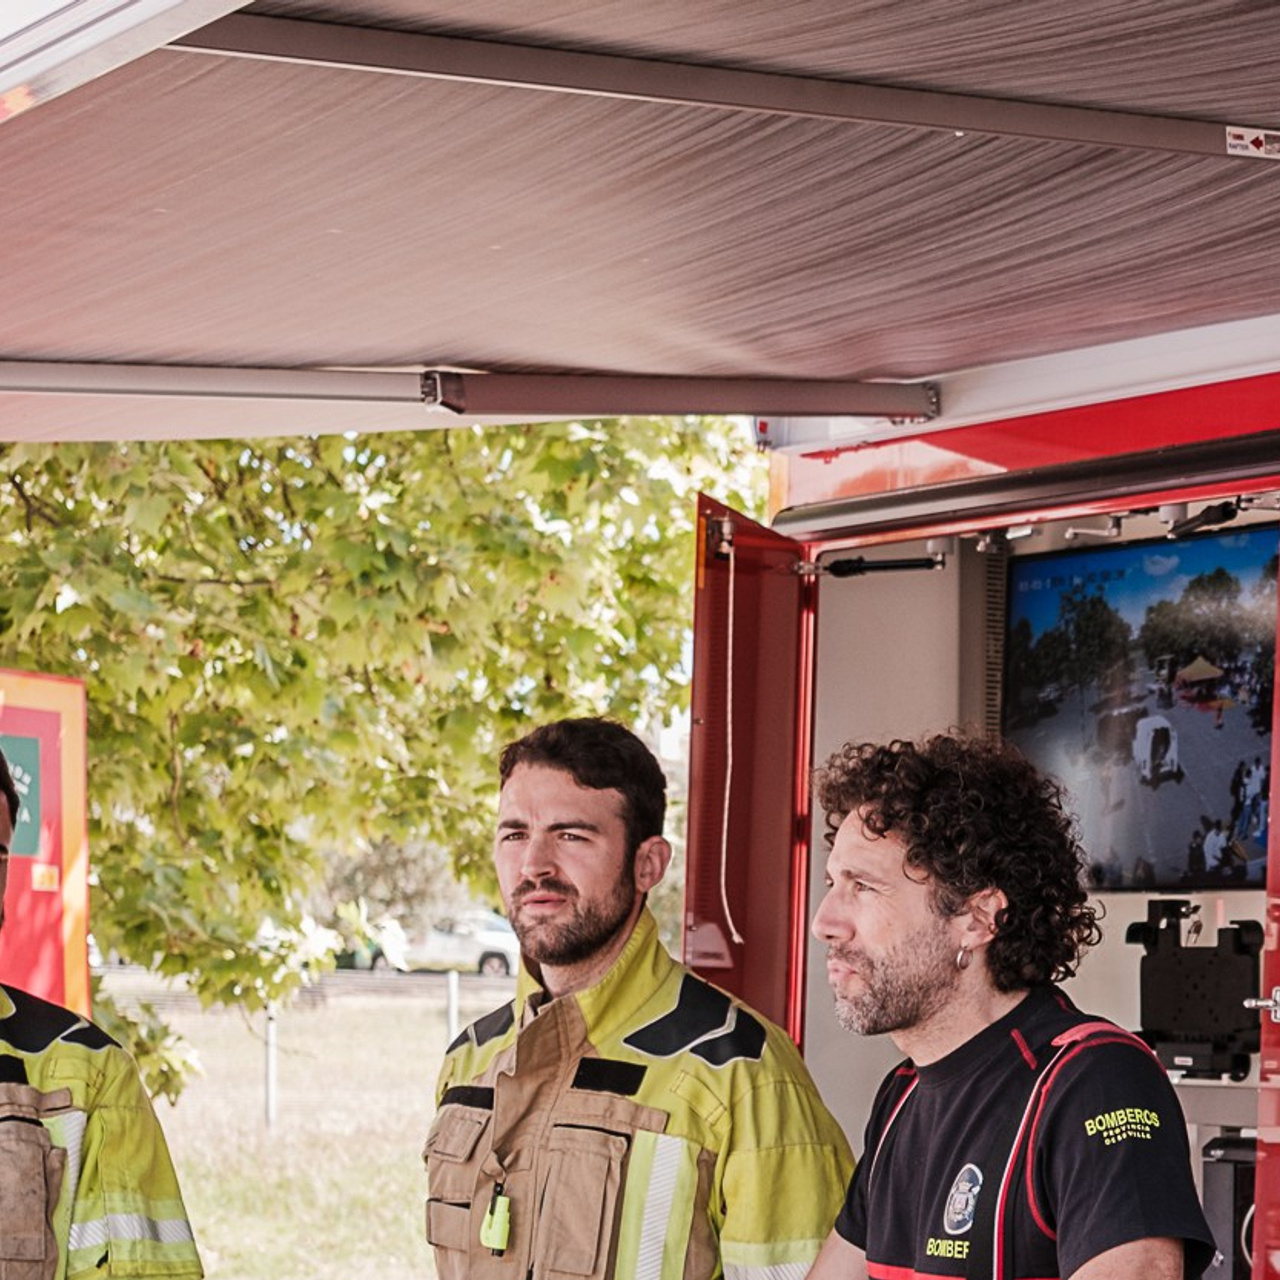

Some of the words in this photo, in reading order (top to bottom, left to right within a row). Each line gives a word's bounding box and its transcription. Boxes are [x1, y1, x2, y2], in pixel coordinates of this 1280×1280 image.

[1085, 1108, 1160, 1136] BOMBEROS
[1103, 1124, 1151, 1138] PROVINCIA
[926, 1238, 970, 1259] BOMBER
